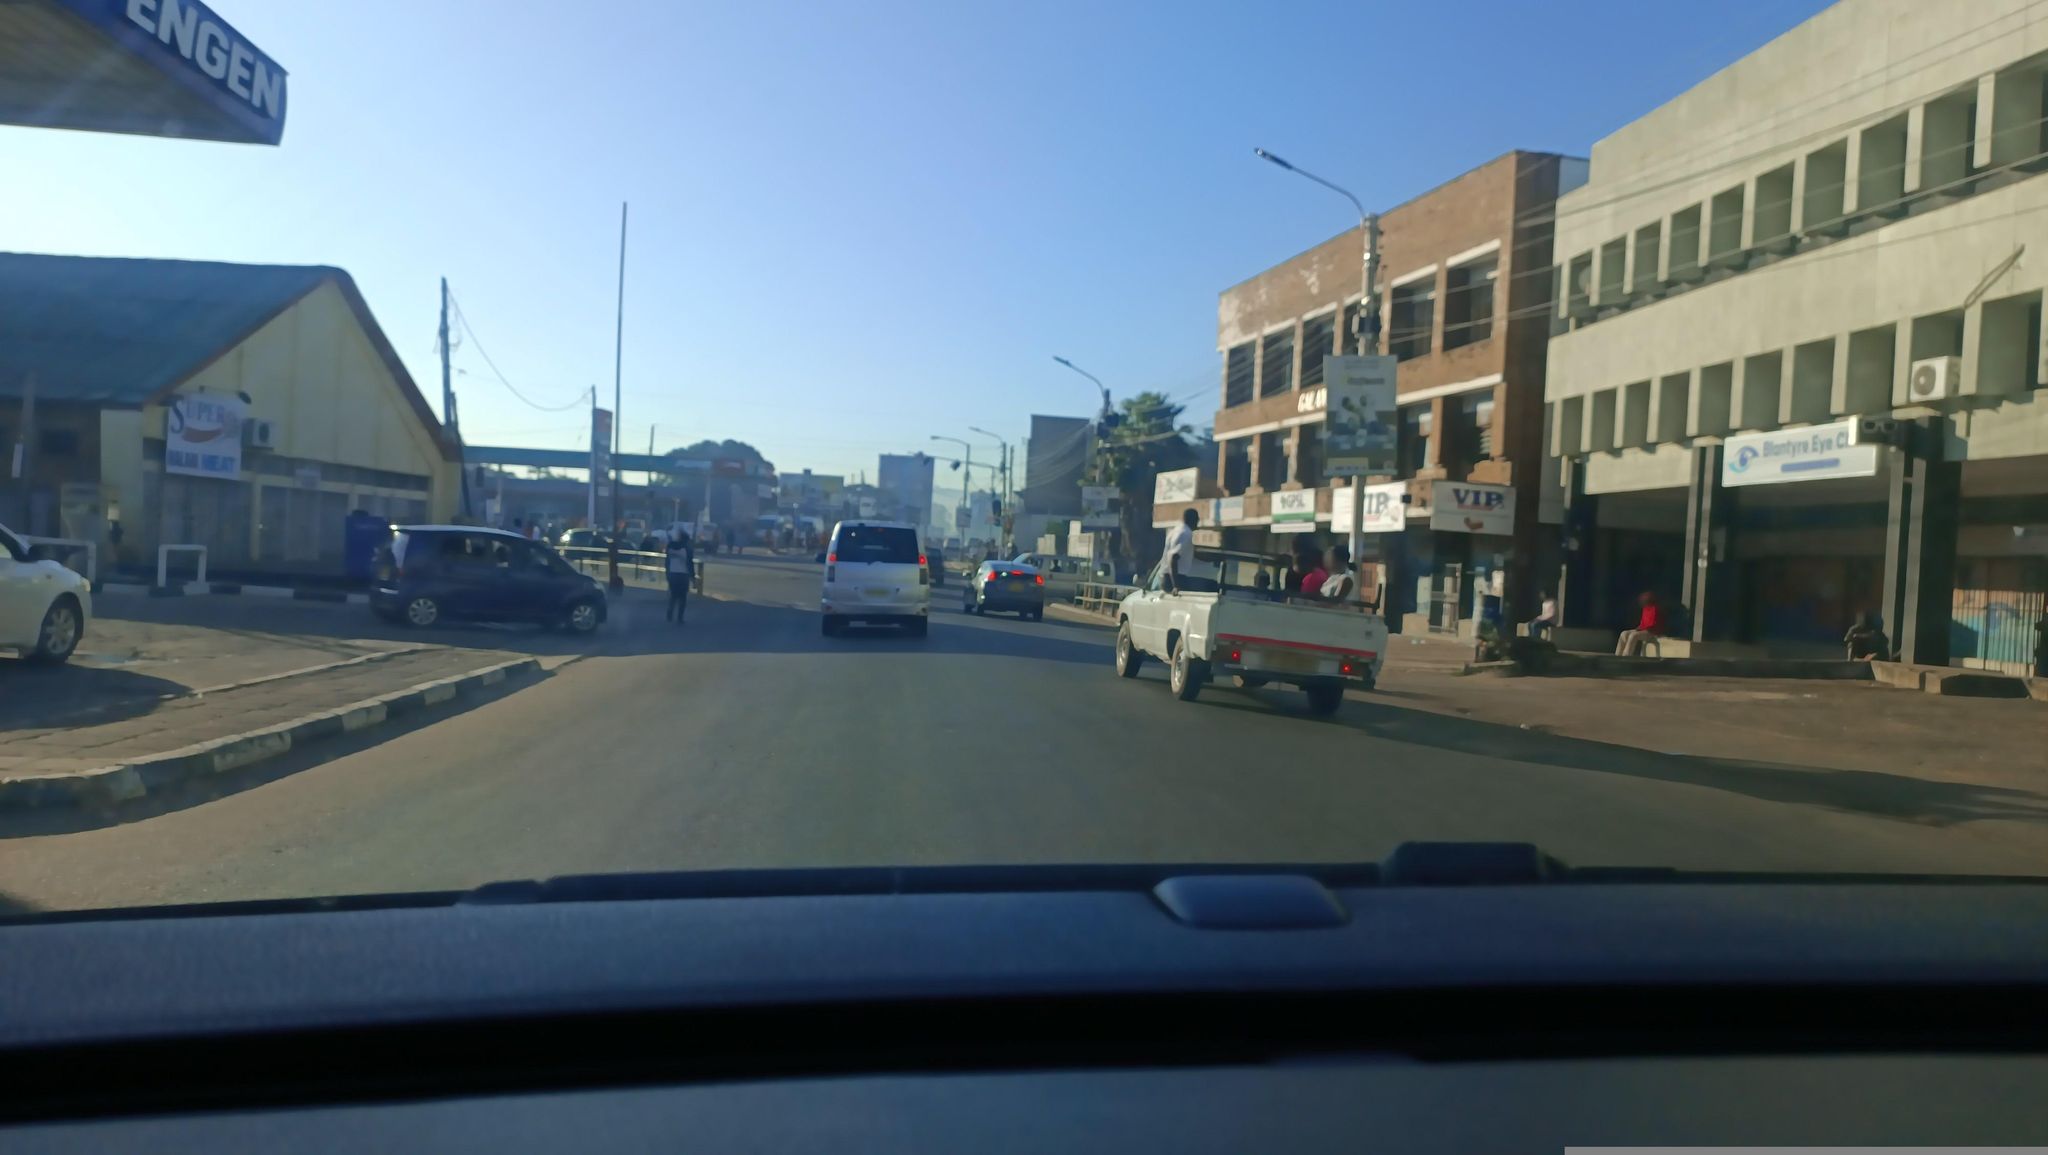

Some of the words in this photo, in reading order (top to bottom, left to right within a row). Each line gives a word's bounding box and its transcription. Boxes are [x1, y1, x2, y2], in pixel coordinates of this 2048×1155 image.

[126, 0, 282, 119] ENGEN
[170, 395, 224, 434] SUPER
[1762, 437, 1808, 457] Blantyre
[1811, 433, 1832, 454] Eye
[1365, 491, 1388, 514] IP
